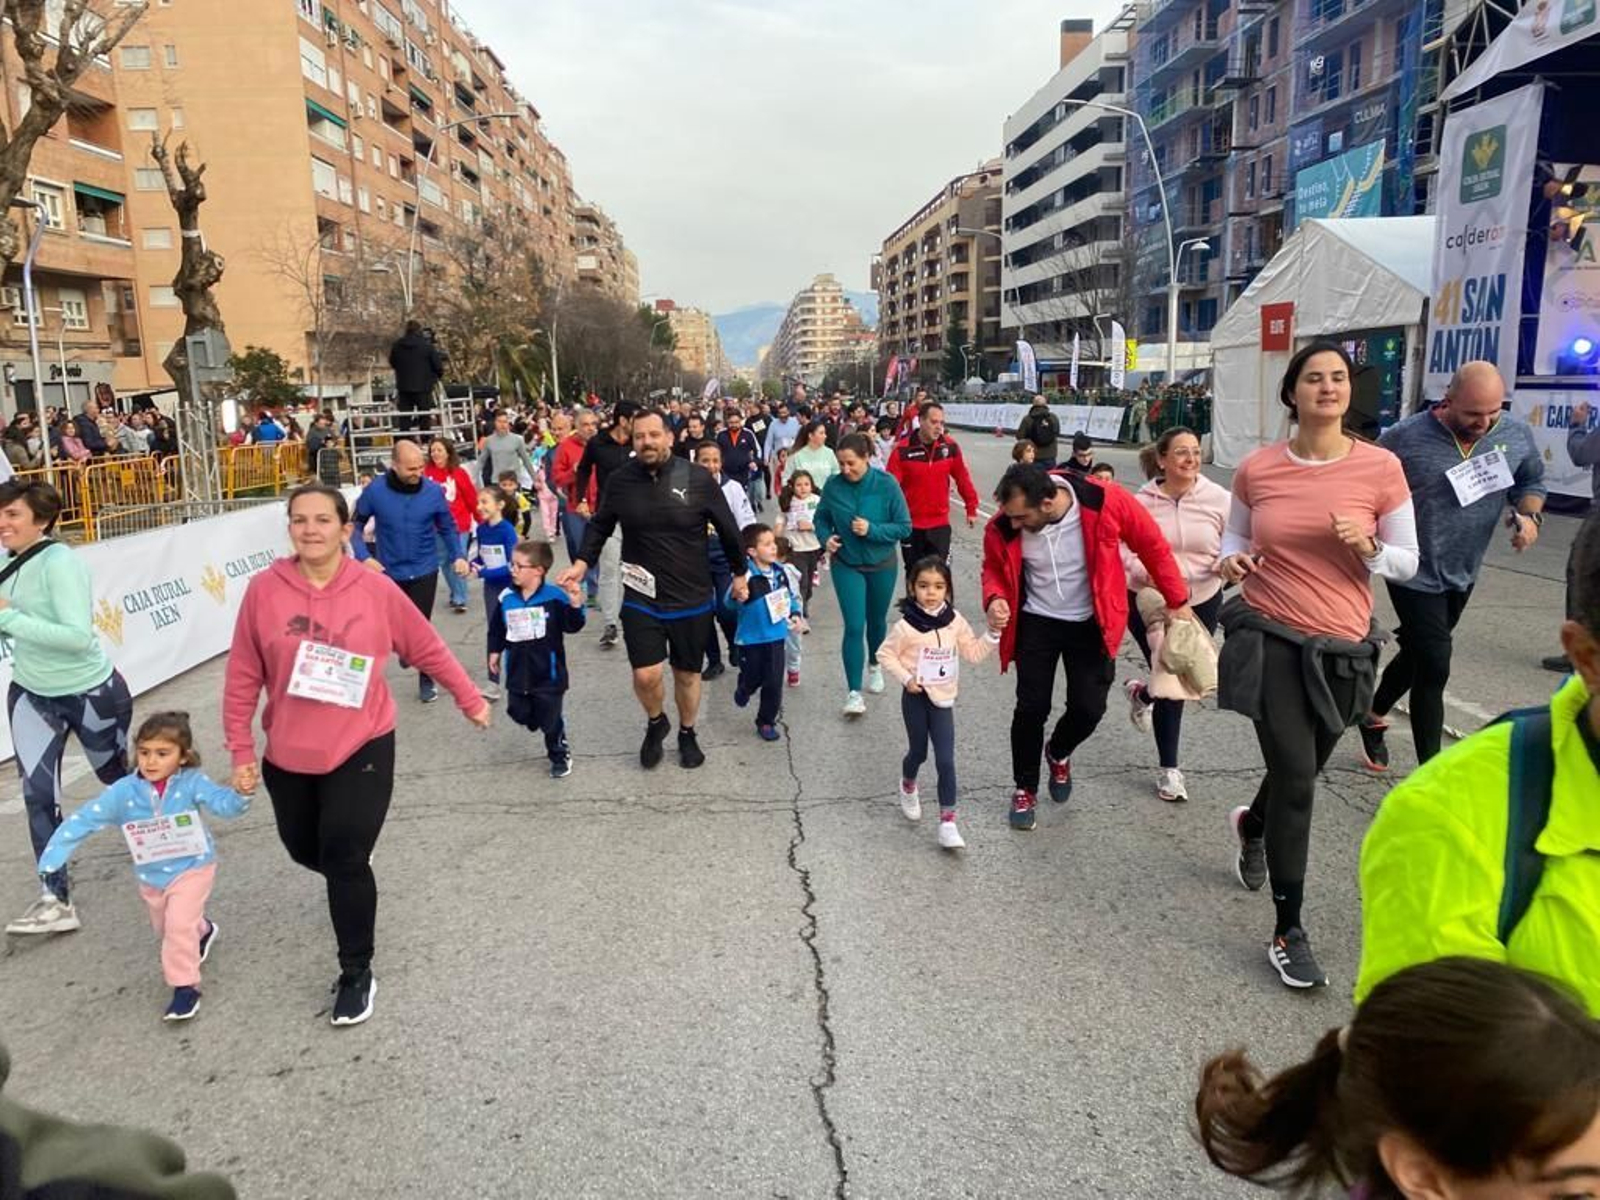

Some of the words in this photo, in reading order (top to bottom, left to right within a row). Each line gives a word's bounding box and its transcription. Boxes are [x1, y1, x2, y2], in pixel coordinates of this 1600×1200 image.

[1433, 278, 1461, 326] 41
[1461, 273, 1507, 324] SAN
[1429, 322, 1501, 374] ANTÓN
[225, 560, 250, 579] CAJA
[123, 590, 154, 615] CAJA
[150, 577, 192, 605] RURAL
[149, 603, 183, 630] JAÉN
